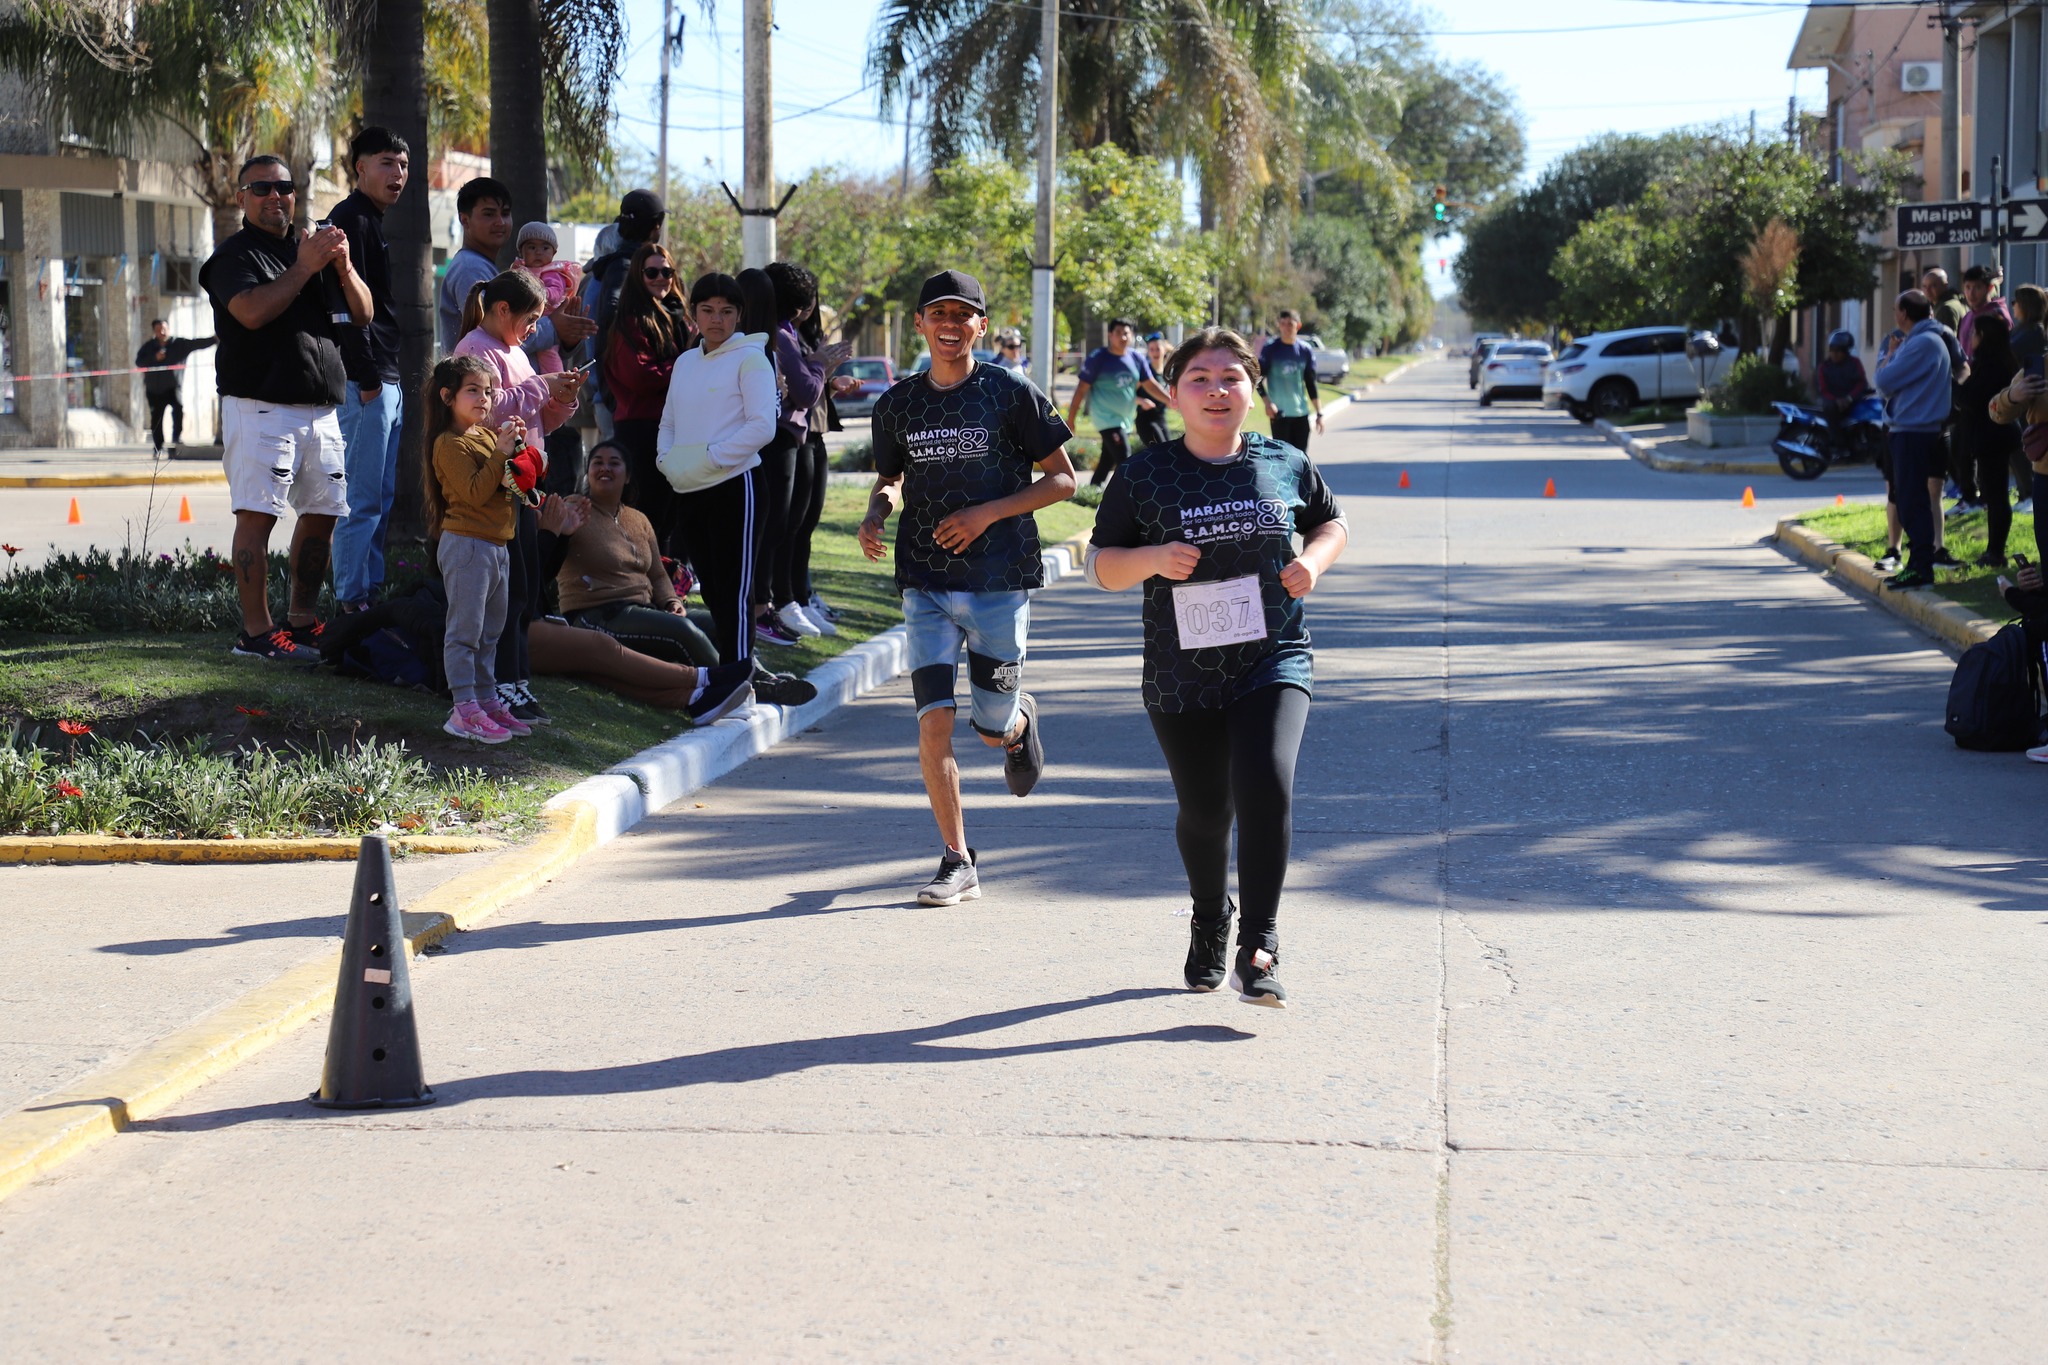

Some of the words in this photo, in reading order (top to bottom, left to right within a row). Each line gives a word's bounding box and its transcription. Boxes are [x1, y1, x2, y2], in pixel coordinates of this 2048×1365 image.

[1912, 207, 1973, 223] Maipú
[1906, 231, 1936, 245] 2200
[1949, 228, 1978, 243] 2300
[906, 428, 957, 443] MARATON
[958, 428, 989, 454] 82
[1180, 500, 1255, 519] MARATON
[1235, 510, 1256, 518] todos
[1256, 499, 1290, 529] 82
[1186, 596, 1249, 635] 037
